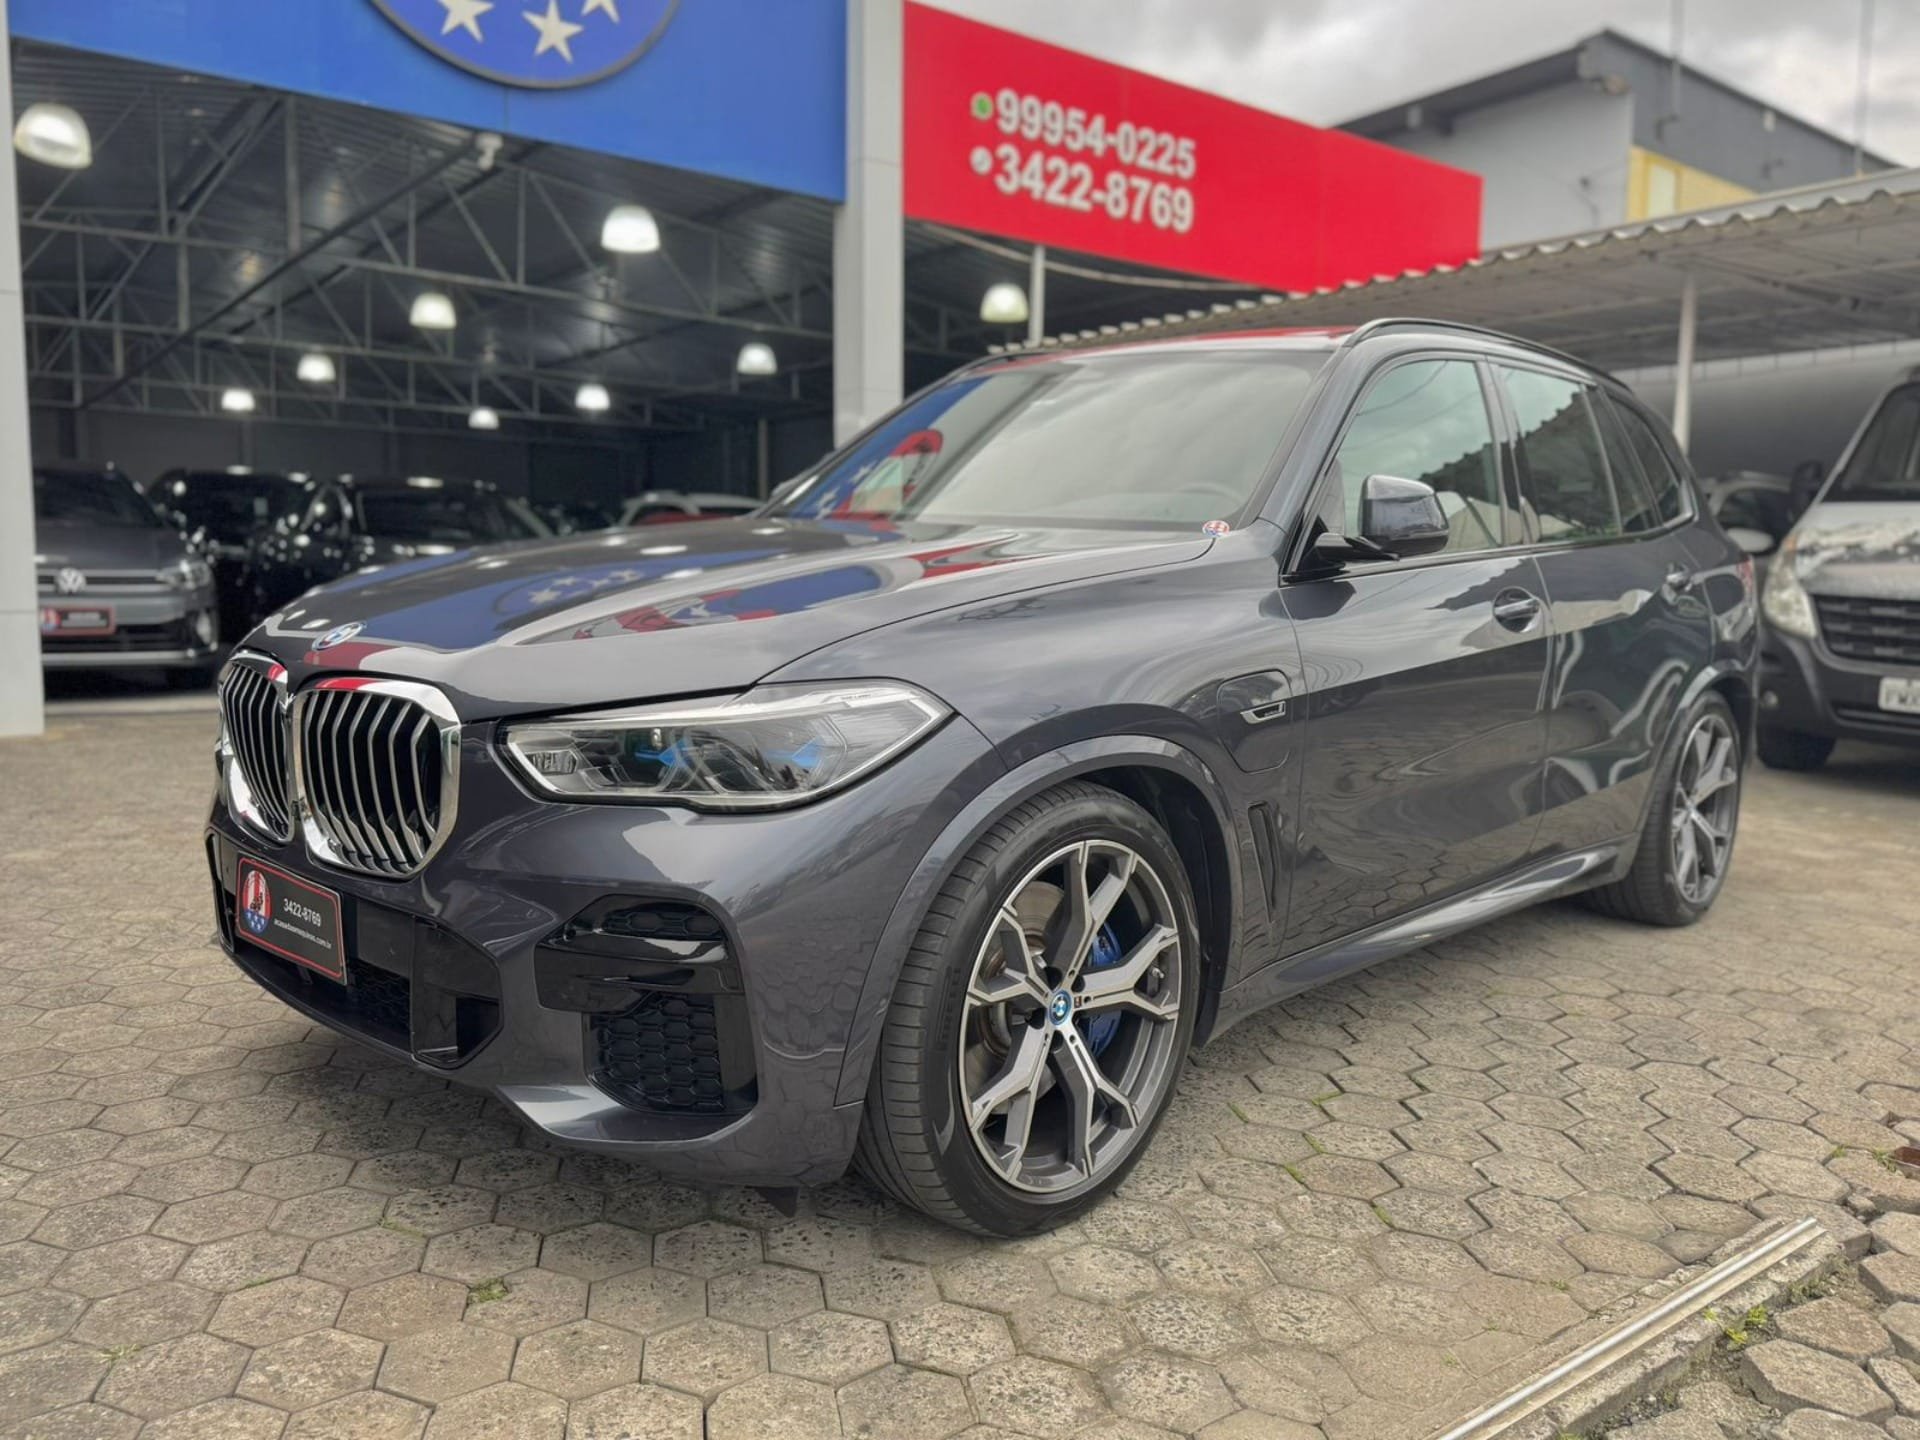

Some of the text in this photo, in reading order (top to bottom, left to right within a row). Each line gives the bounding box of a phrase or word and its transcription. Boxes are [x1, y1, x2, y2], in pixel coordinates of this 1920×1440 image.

[996, 88, 1196, 180] 99954-0225
[994, 143, 1195, 233] 3422-8769
[283, 898, 321, 927] 3422-8769
